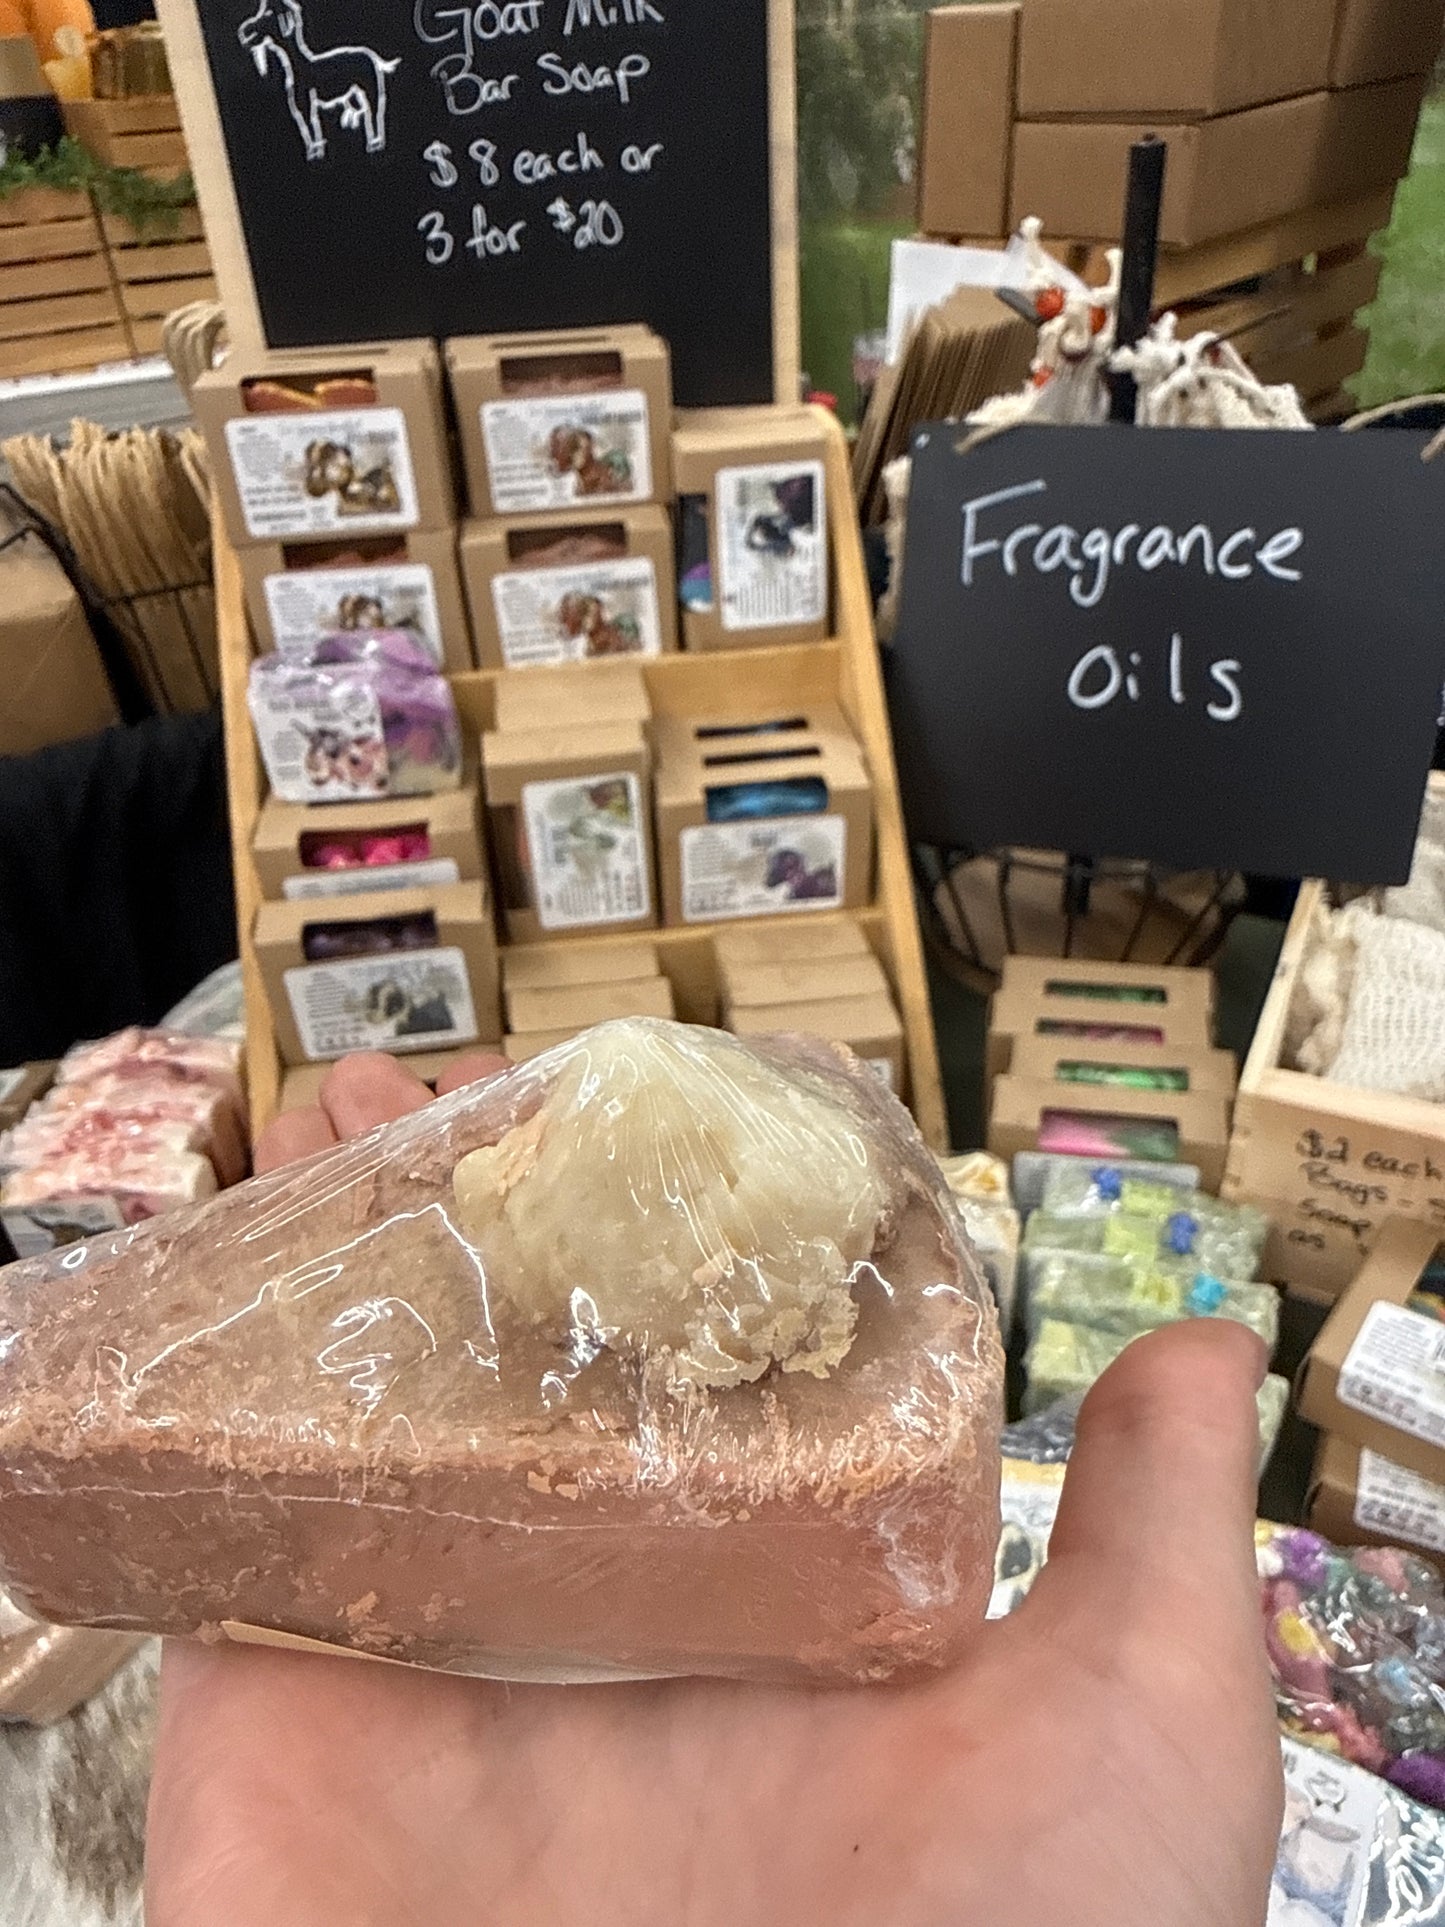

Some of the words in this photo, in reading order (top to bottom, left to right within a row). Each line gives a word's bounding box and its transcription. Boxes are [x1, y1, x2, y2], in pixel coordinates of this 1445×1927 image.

[413, 0, 544, 56] Goat
[431, 54, 520, 115] Bar
[536, 53, 650, 103] Soap
[513, 131, 604, 185] each
[620, 143, 664, 173] or
[417, 210, 454, 264] 3
[465, 203, 527, 259] for
[546, 197, 624, 250] $20
[961, 479, 1303, 608] Fragrance
[1067, 632, 1242, 721] Oils
[1363, 1150, 1443, 1181] each
